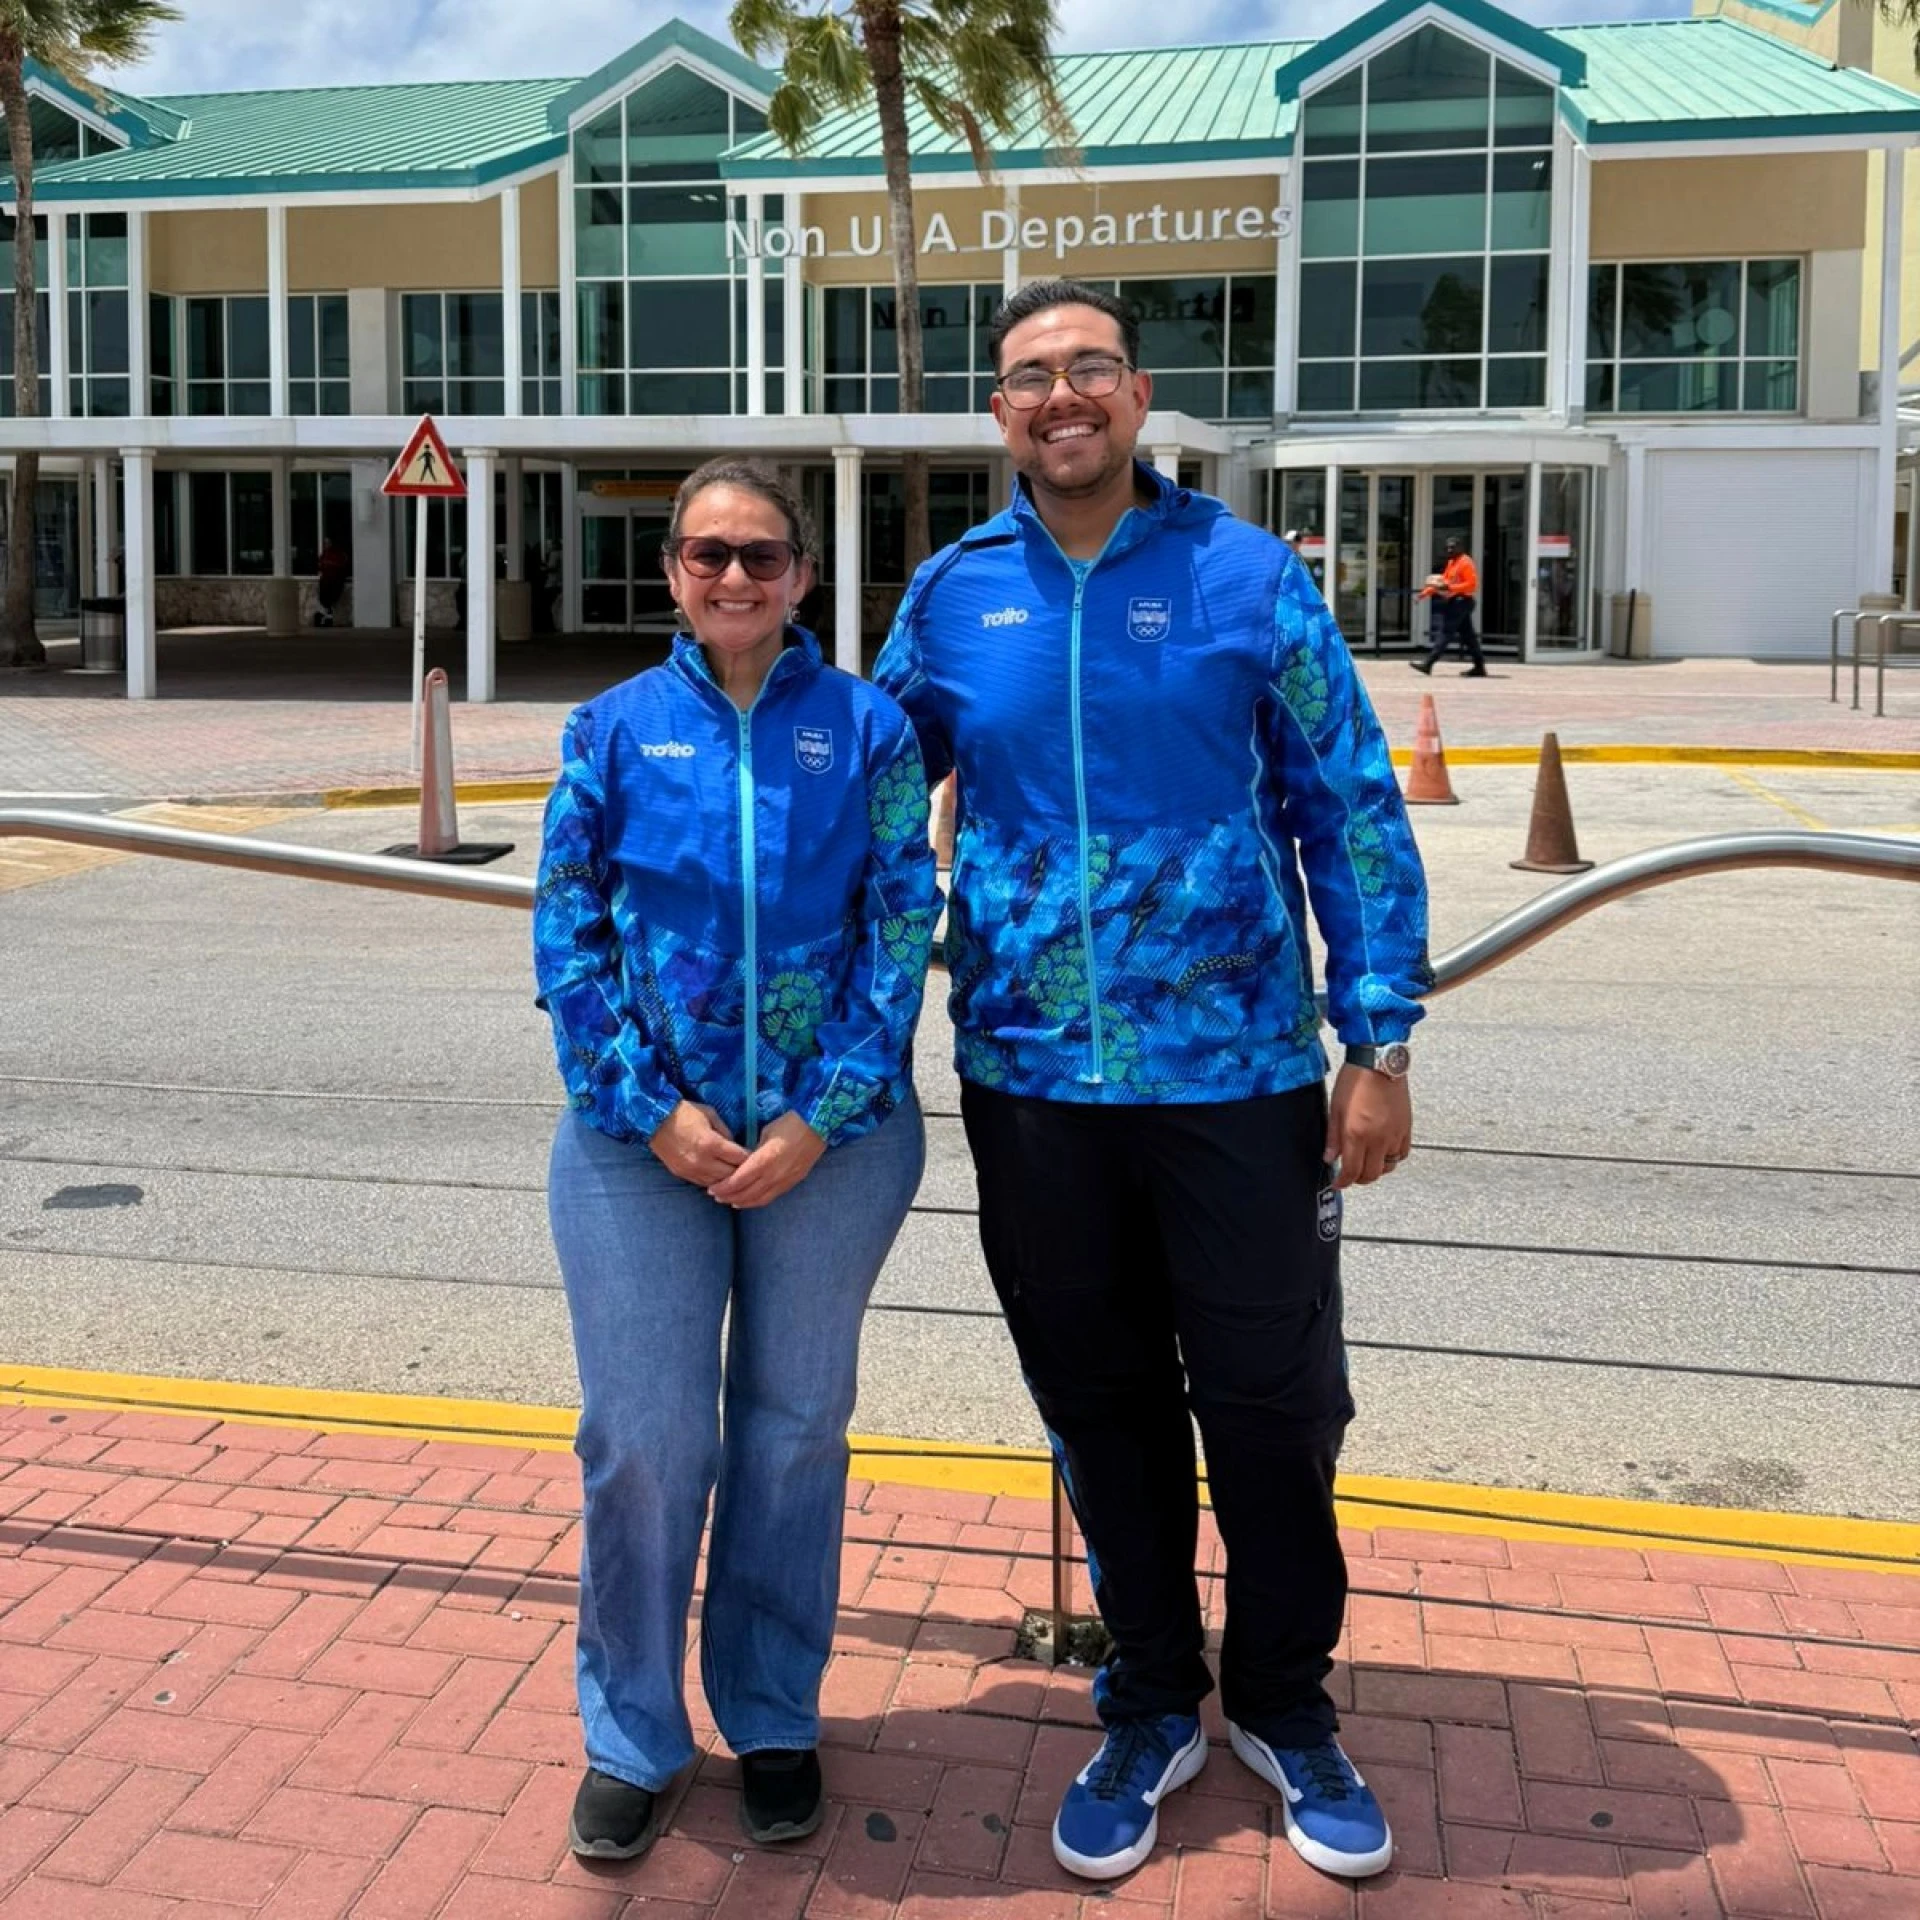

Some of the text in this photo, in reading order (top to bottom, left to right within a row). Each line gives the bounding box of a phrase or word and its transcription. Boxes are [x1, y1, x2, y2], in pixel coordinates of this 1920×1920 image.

[725, 203, 1294, 260] Non UA Departures
